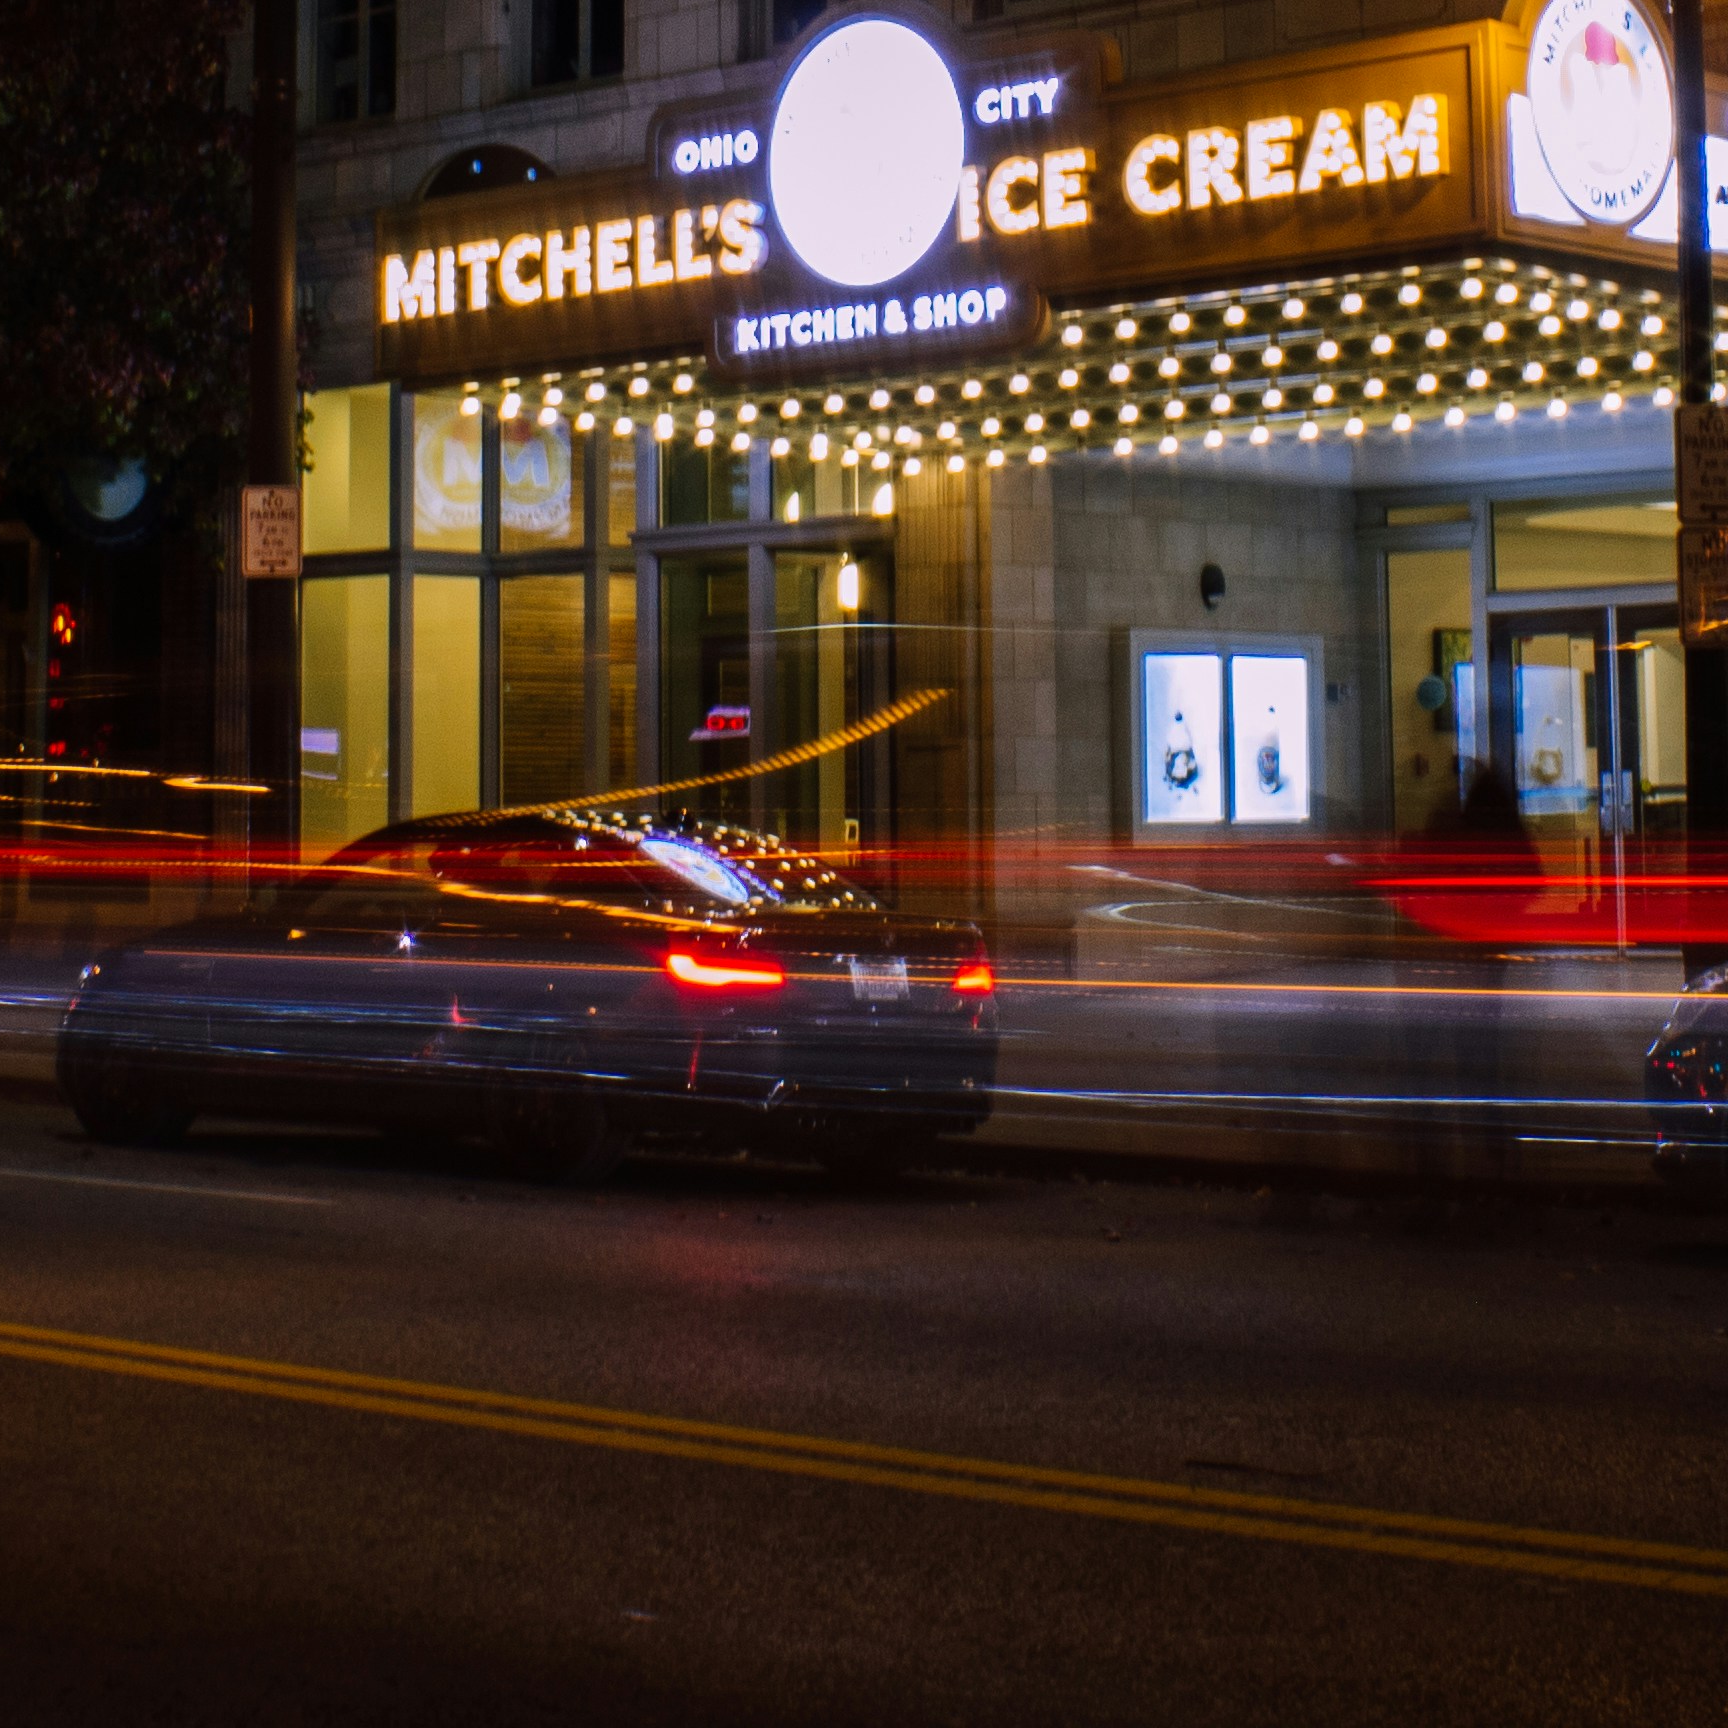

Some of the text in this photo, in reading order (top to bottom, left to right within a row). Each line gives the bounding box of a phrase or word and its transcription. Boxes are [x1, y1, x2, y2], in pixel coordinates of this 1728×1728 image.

[674, 76, 1060, 174] OHIO CITY
[381, 198, 766, 324] MITCHELL'S
[958, 146, 1097, 243] ICE
[1123, 92, 1449, 216] CREAM
[737, 286, 1007, 354] KITCHEN & SHOP
[1699, 418, 1725, 432] NO
[250, 510, 295, 520] PARKING
[262, 496, 283, 507] NO
